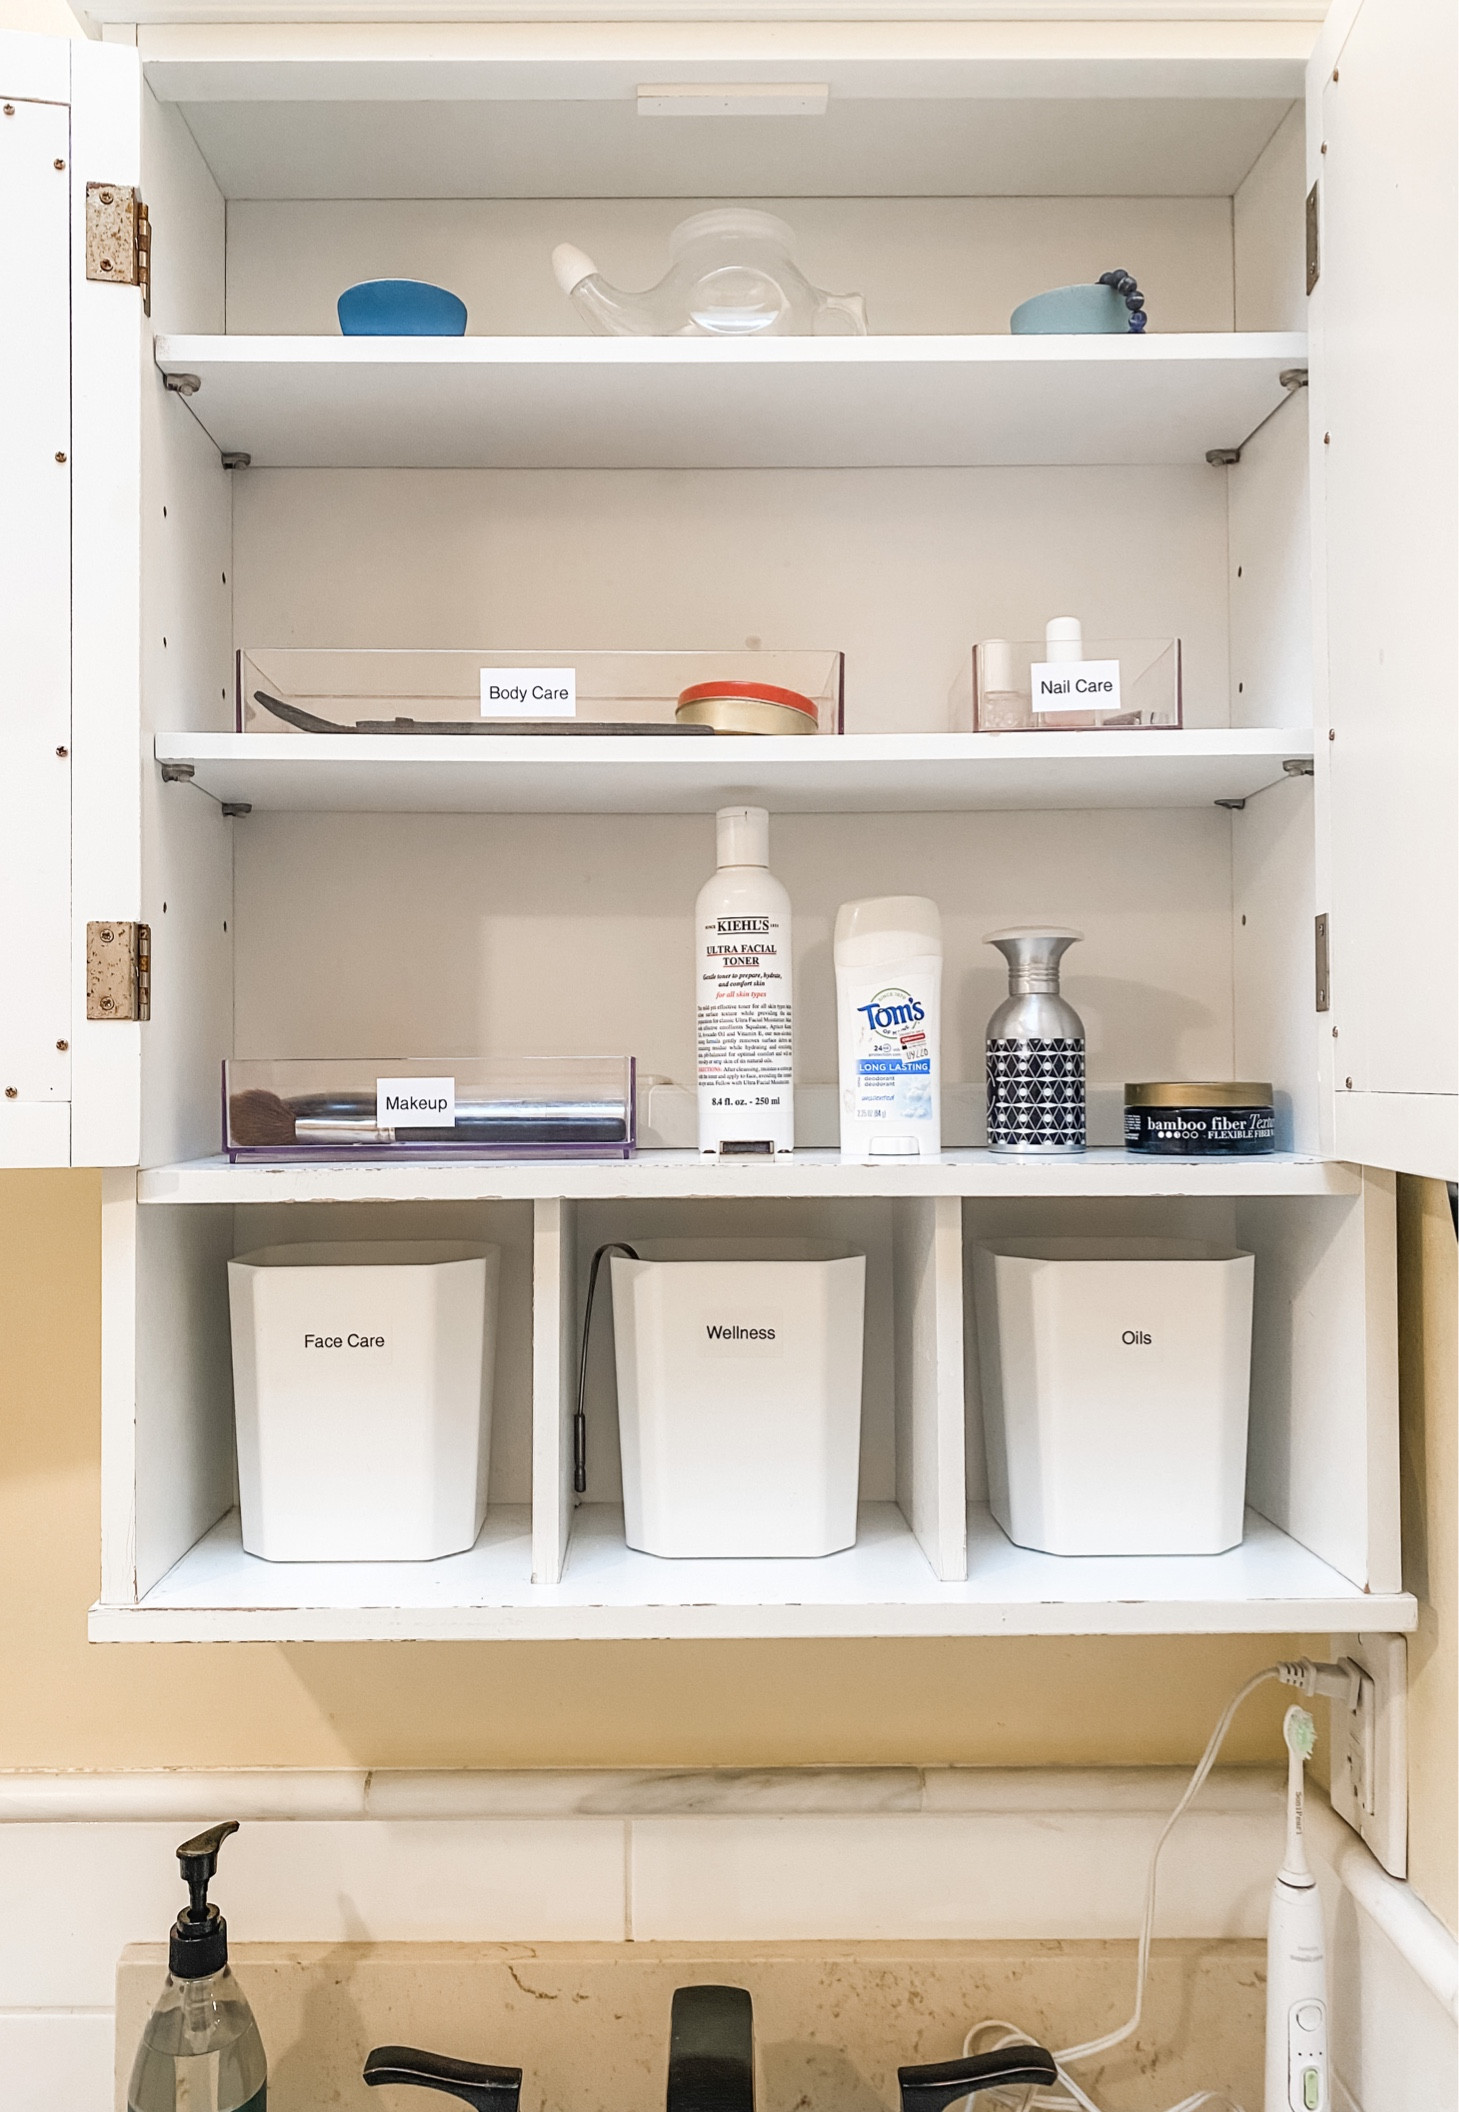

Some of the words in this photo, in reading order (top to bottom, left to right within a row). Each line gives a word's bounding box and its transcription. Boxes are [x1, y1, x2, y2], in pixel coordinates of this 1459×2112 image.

[1041, 680, 1070, 694] Nail
[1075, 679, 1113, 693] Care
[489, 686, 528, 703] Body
[532, 686, 569, 700] Care
[718, 920, 769, 931] KIEHL'S
[706, 945, 738, 954] ULTRA
[741, 944, 776, 952] FACIAL
[723, 957, 759, 965] TONER
[716, 991, 725, 999] for
[857, 997, 924, 1030] Tom's
[859, 1063, 886, 1071] LONG
[889, 1063, 928, 1071] LASTING
[387, 1096, 448, 1113] Makeup
[712, 1097, 722, 1105] 8.4
[724, 1097, 733, 1105] fl.
[755, 1097, 769, 1105] 250
[771, 1096, 780, 1104] ml
[1147, 1117, 1207, 1130] bamboo
[1212, 1117, 1247, 1130] fiber
[1207, 1130, 1253, 1139] FLEXIBLE
[1254, 1130, 1271, 1138] FIBER
[706, 1325, 776, 1340] Wellness
[1121, 1330, 1152, 1346] Oils
[304, 1334, 343, 1349] Face
[347, 1333, 385, 1348] Care
